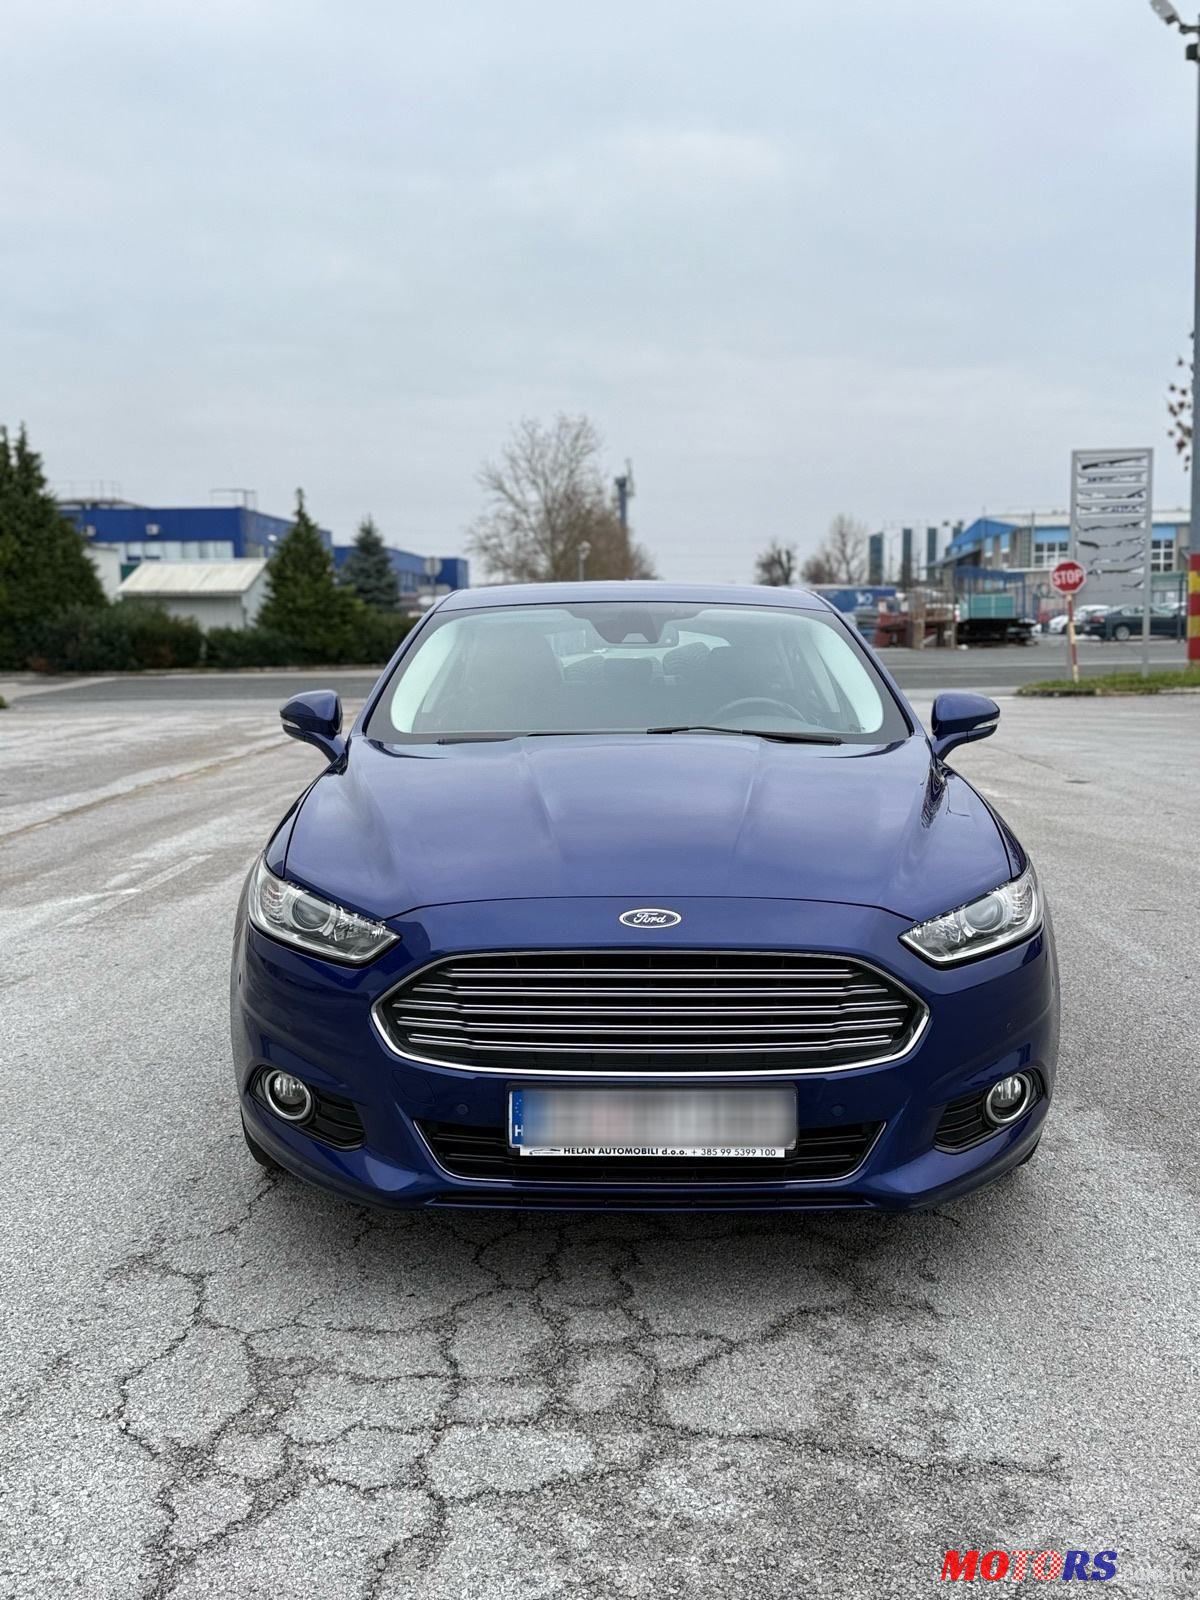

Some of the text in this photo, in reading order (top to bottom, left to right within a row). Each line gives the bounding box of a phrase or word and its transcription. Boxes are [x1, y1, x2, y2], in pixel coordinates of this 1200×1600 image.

[1053, 569, 1083, 586] STOP
[633, 912, 667, 924] Ford
[563, 1147, 595, 1155] HELAN
[598, 1147, 659, 1155] AUTOMOBILI
[661, 1147, 688, 1155] d.o.o.
[700, 1148, 718, 1156] 385
[720, 1148, 732, 1156] 99
[734, 1148, 757, 1156] 5399
[760, 1149, 777, 1157] 100
